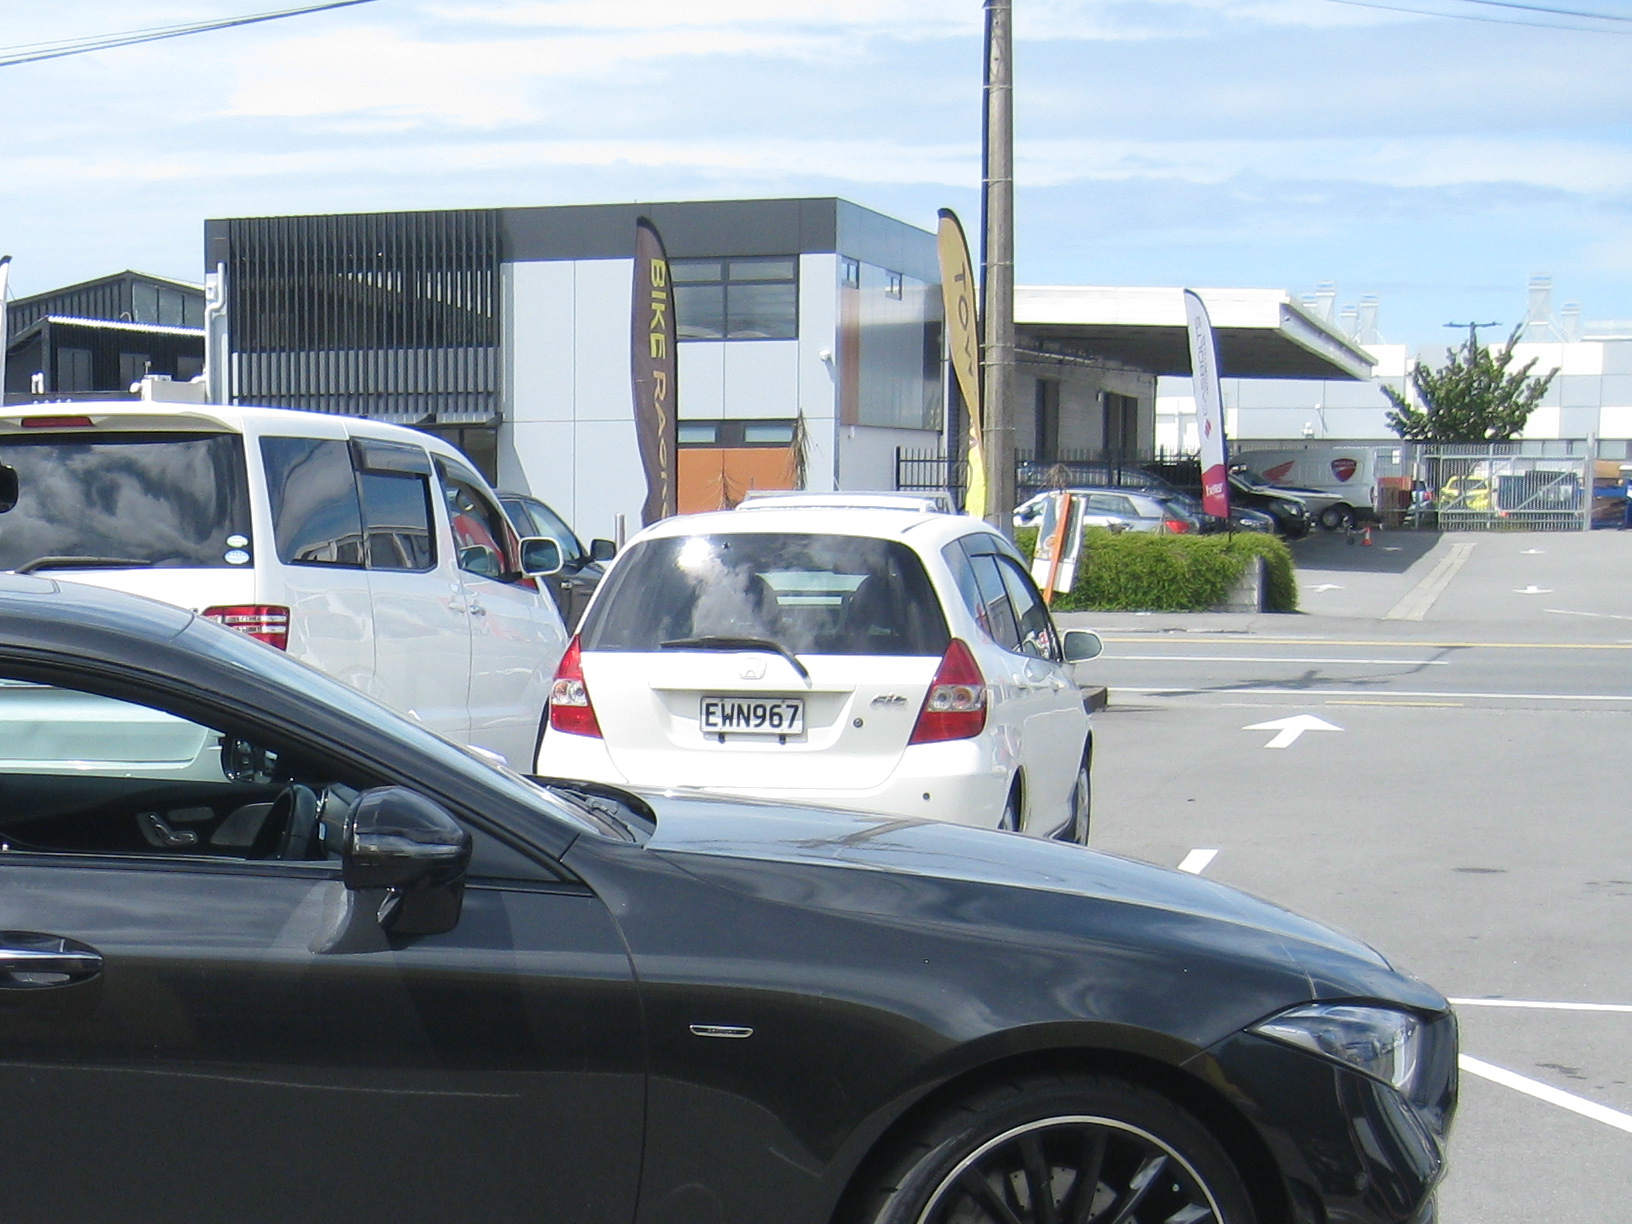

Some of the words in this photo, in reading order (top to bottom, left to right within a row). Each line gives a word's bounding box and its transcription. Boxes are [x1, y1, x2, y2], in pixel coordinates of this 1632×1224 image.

[650, 258, 666, 360] BIKE
[652, 369, 669, 519] RAC
[704, 702, 800, 729] EWN967
